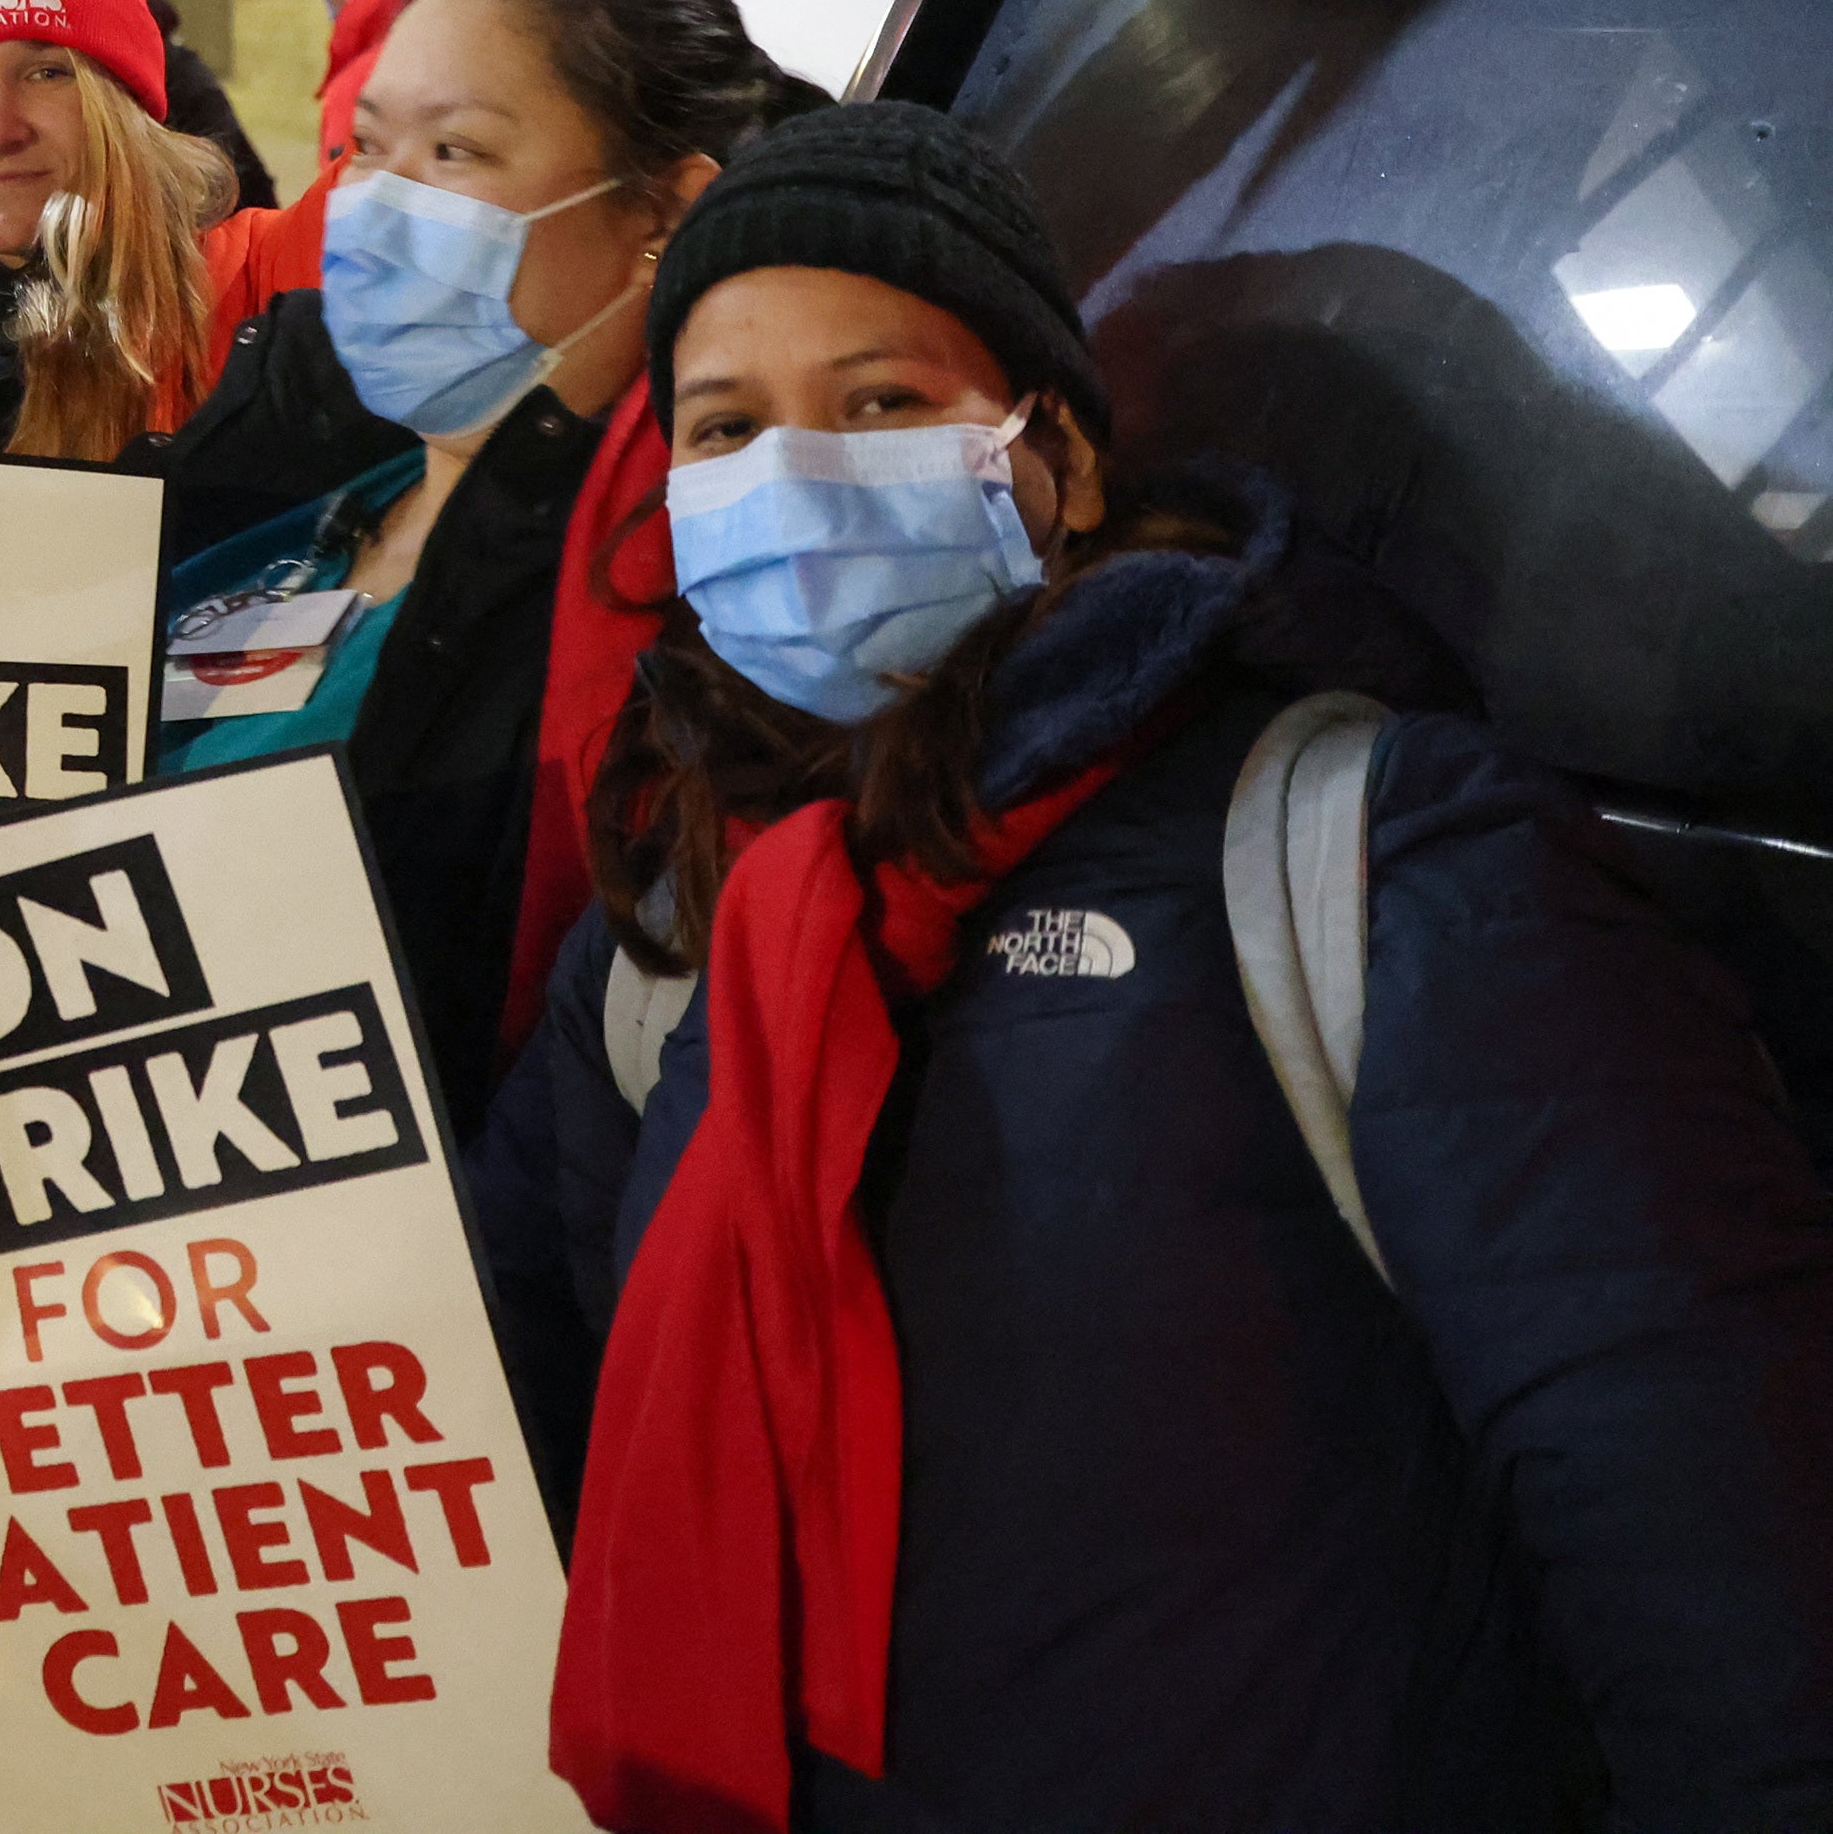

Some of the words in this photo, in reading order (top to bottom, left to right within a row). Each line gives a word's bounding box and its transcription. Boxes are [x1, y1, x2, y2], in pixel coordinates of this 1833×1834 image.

[1027, 909, 1085, 934] THE
[987, 930, 1081, 955] NORTH
[1005, 951, 1080, 977] FACE
[12, 1237, 271, 1363] FOR
[41, 1596, 436, 1736] CARE
[158, 1767, 358, 1823] NURSES
